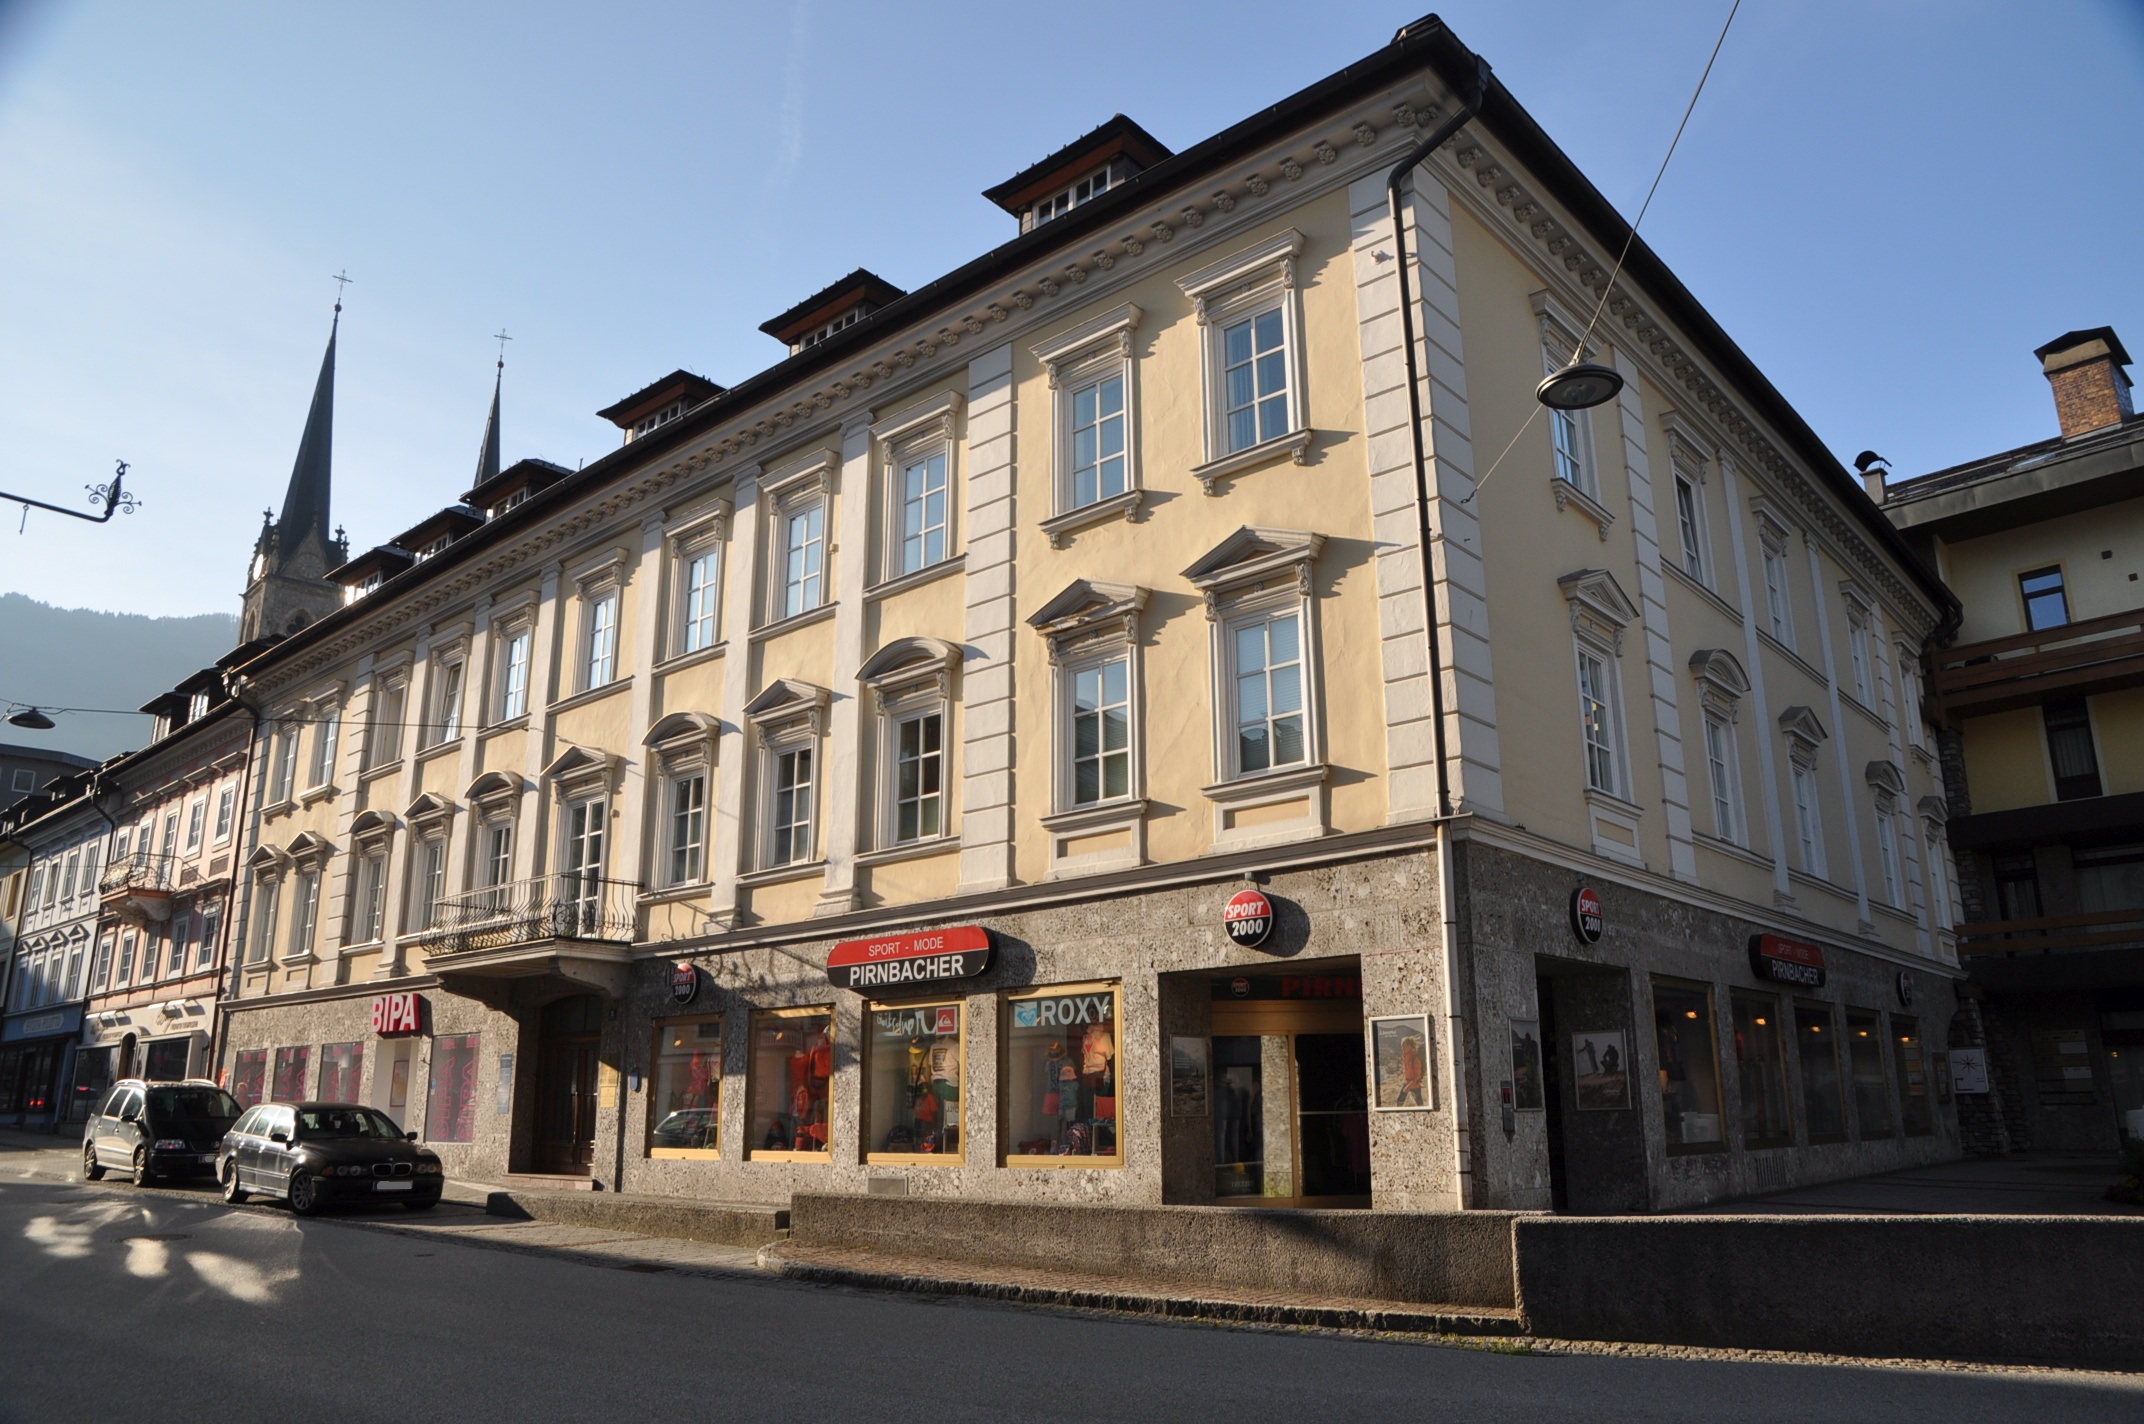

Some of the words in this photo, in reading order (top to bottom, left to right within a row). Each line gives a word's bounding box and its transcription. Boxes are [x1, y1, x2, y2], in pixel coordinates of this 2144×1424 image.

[1227, 901, 1264, 919] SPORT
[1581, 899, 1600, 915] SPORT
[1231, 918, 1264, 937] 2000
[1585, 916, 1601, 932] 2000
[868, 941, 901, 957] SPORT
[913, 936, 944, 952] MODE
[1777, 943, 1792, 956] SPORT
[1797, 948, 1809, 960] MODE
[673, 971, 692, 983] SPORT
[849, 954, 964, 986] PIRNBACHER
[1771, 960, 1820, 986] PIRNBACHER
[674, 984, 691, 996] 2000
[1281, 976, 1362, 998] PIRN
[370, 993, 416, 1033] BIPA
[1040, 996, 1111, 1026] ROXY
